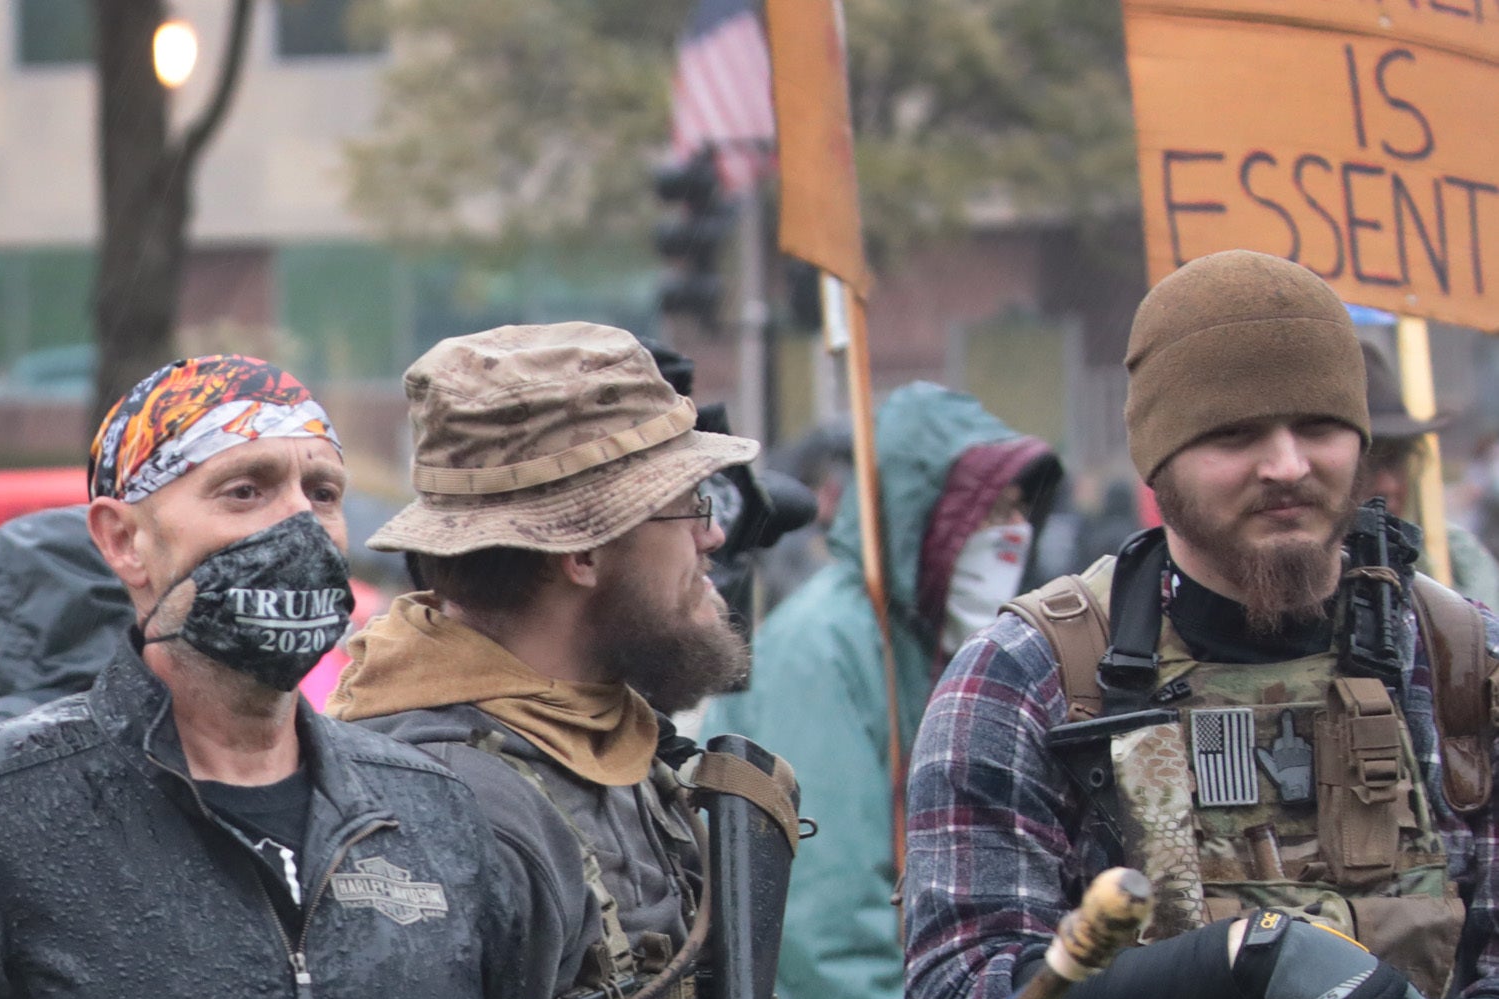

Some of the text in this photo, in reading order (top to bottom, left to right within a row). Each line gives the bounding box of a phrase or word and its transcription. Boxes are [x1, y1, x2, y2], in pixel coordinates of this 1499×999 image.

[1344, 43, 1435, 161] IS
[228, 587, 346, 619] TRUMP
[259, 628, 326, 654] 2020
